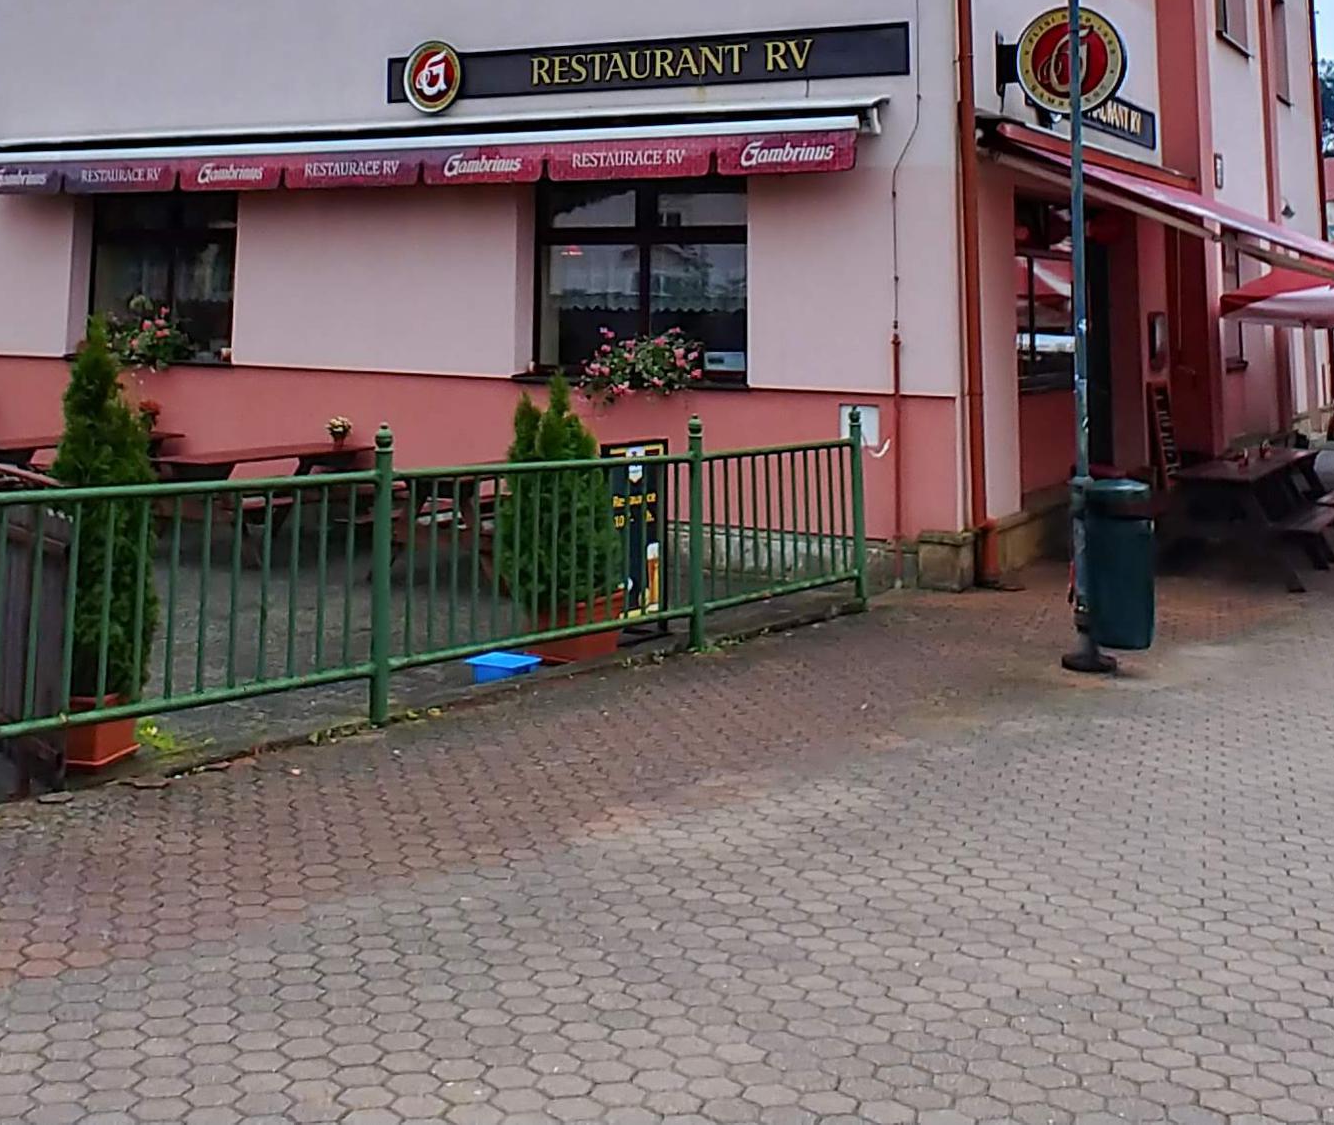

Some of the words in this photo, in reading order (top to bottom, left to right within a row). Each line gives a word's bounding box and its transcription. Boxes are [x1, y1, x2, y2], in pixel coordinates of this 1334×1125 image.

[531, 43, 749, 85] RESTAURANT
[764, 38, 813, 72] RV
[572, 150, 662, 168] RESTAURACE
[665, 148, 686, 165] RV
[740, 140, 835, 167] Gambrinus
[81, 168, 145, 183] RESTAURACE
[146, 167, 163, 181] RV
[197, 162, 264, 183] Gambrinus
[304, 161, 381, 177] RESTAURACE
[383, 160, 400, 175] RV
[444, 153, 522, 178] Gambrinus
